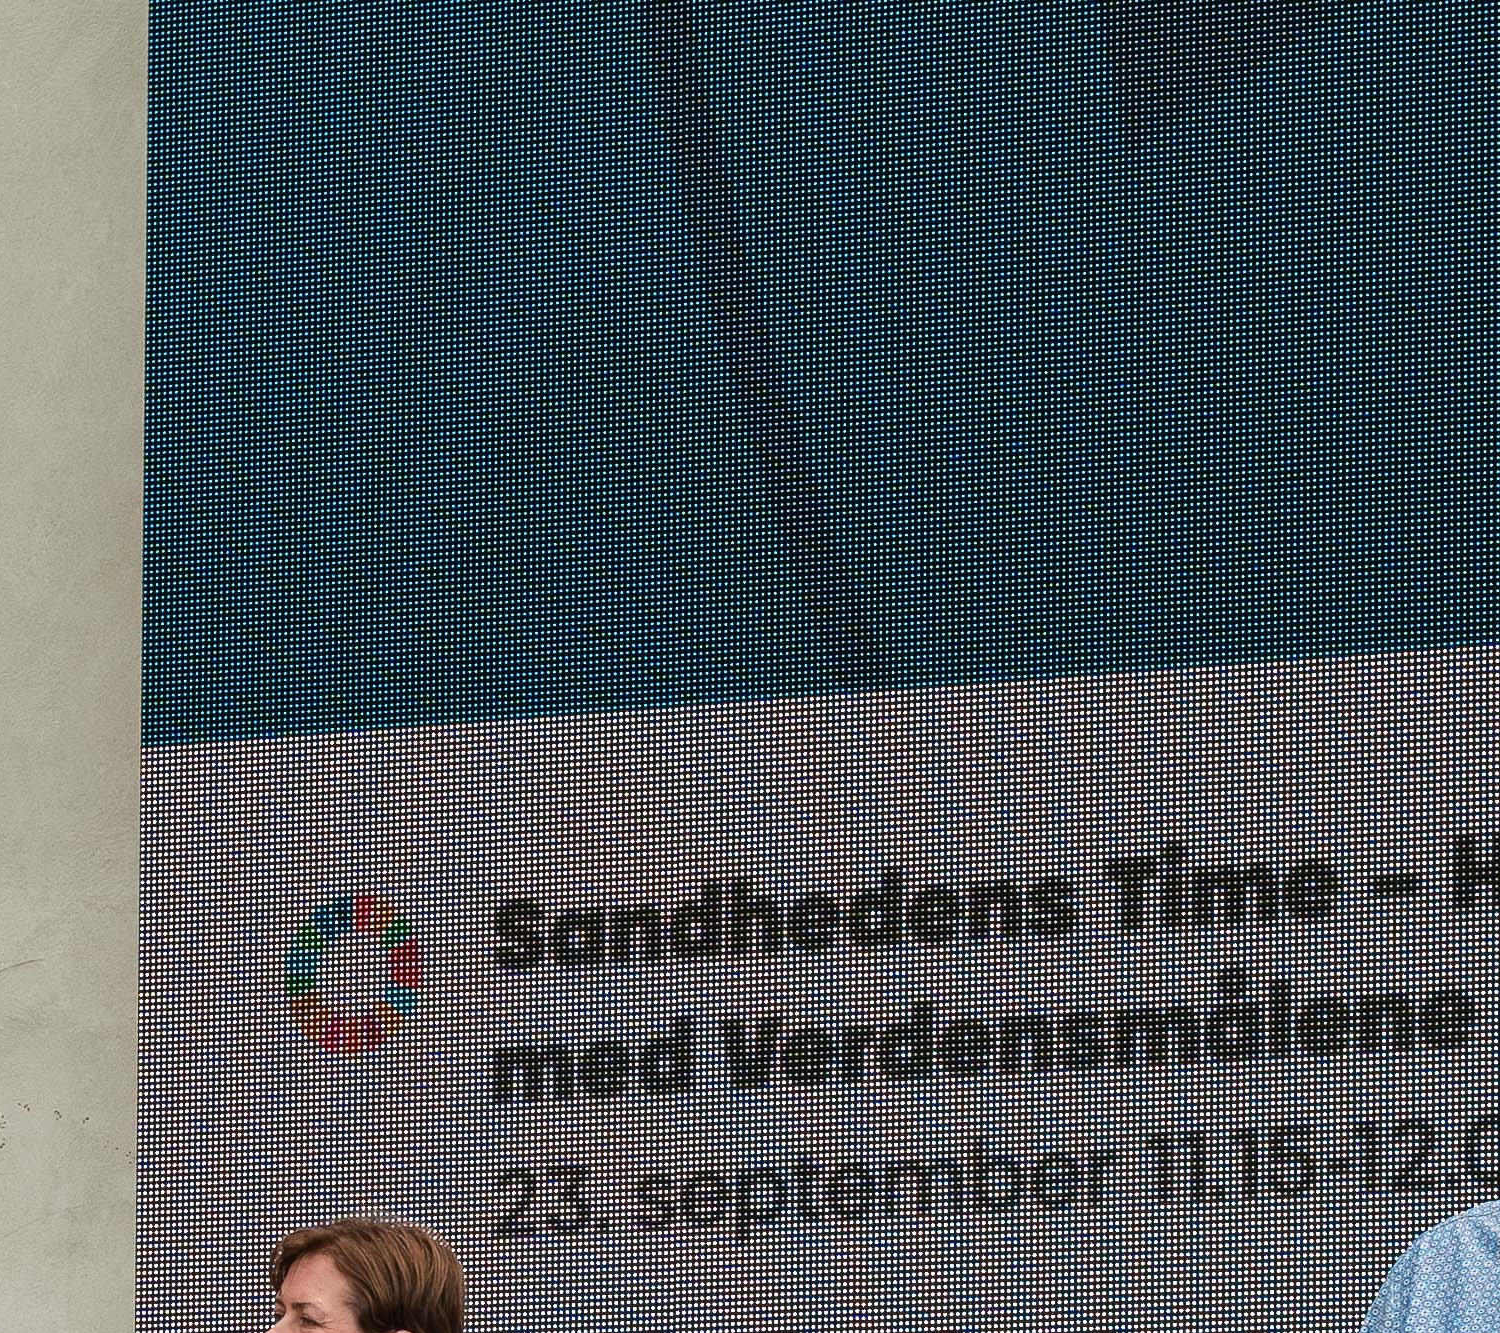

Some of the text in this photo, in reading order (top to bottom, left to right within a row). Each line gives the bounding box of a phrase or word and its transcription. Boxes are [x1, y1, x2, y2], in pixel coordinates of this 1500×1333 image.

[493, 867, 1078, 973] Sandhedens
[1105, 841, 1342, 934] Time
[492, 1016, 695, 1104] med
[721, 966, 1476, 1090] Verdensmålene
[494, 1165, 611, 1240] 23.
[635, 1137, 1116, 1244] september
